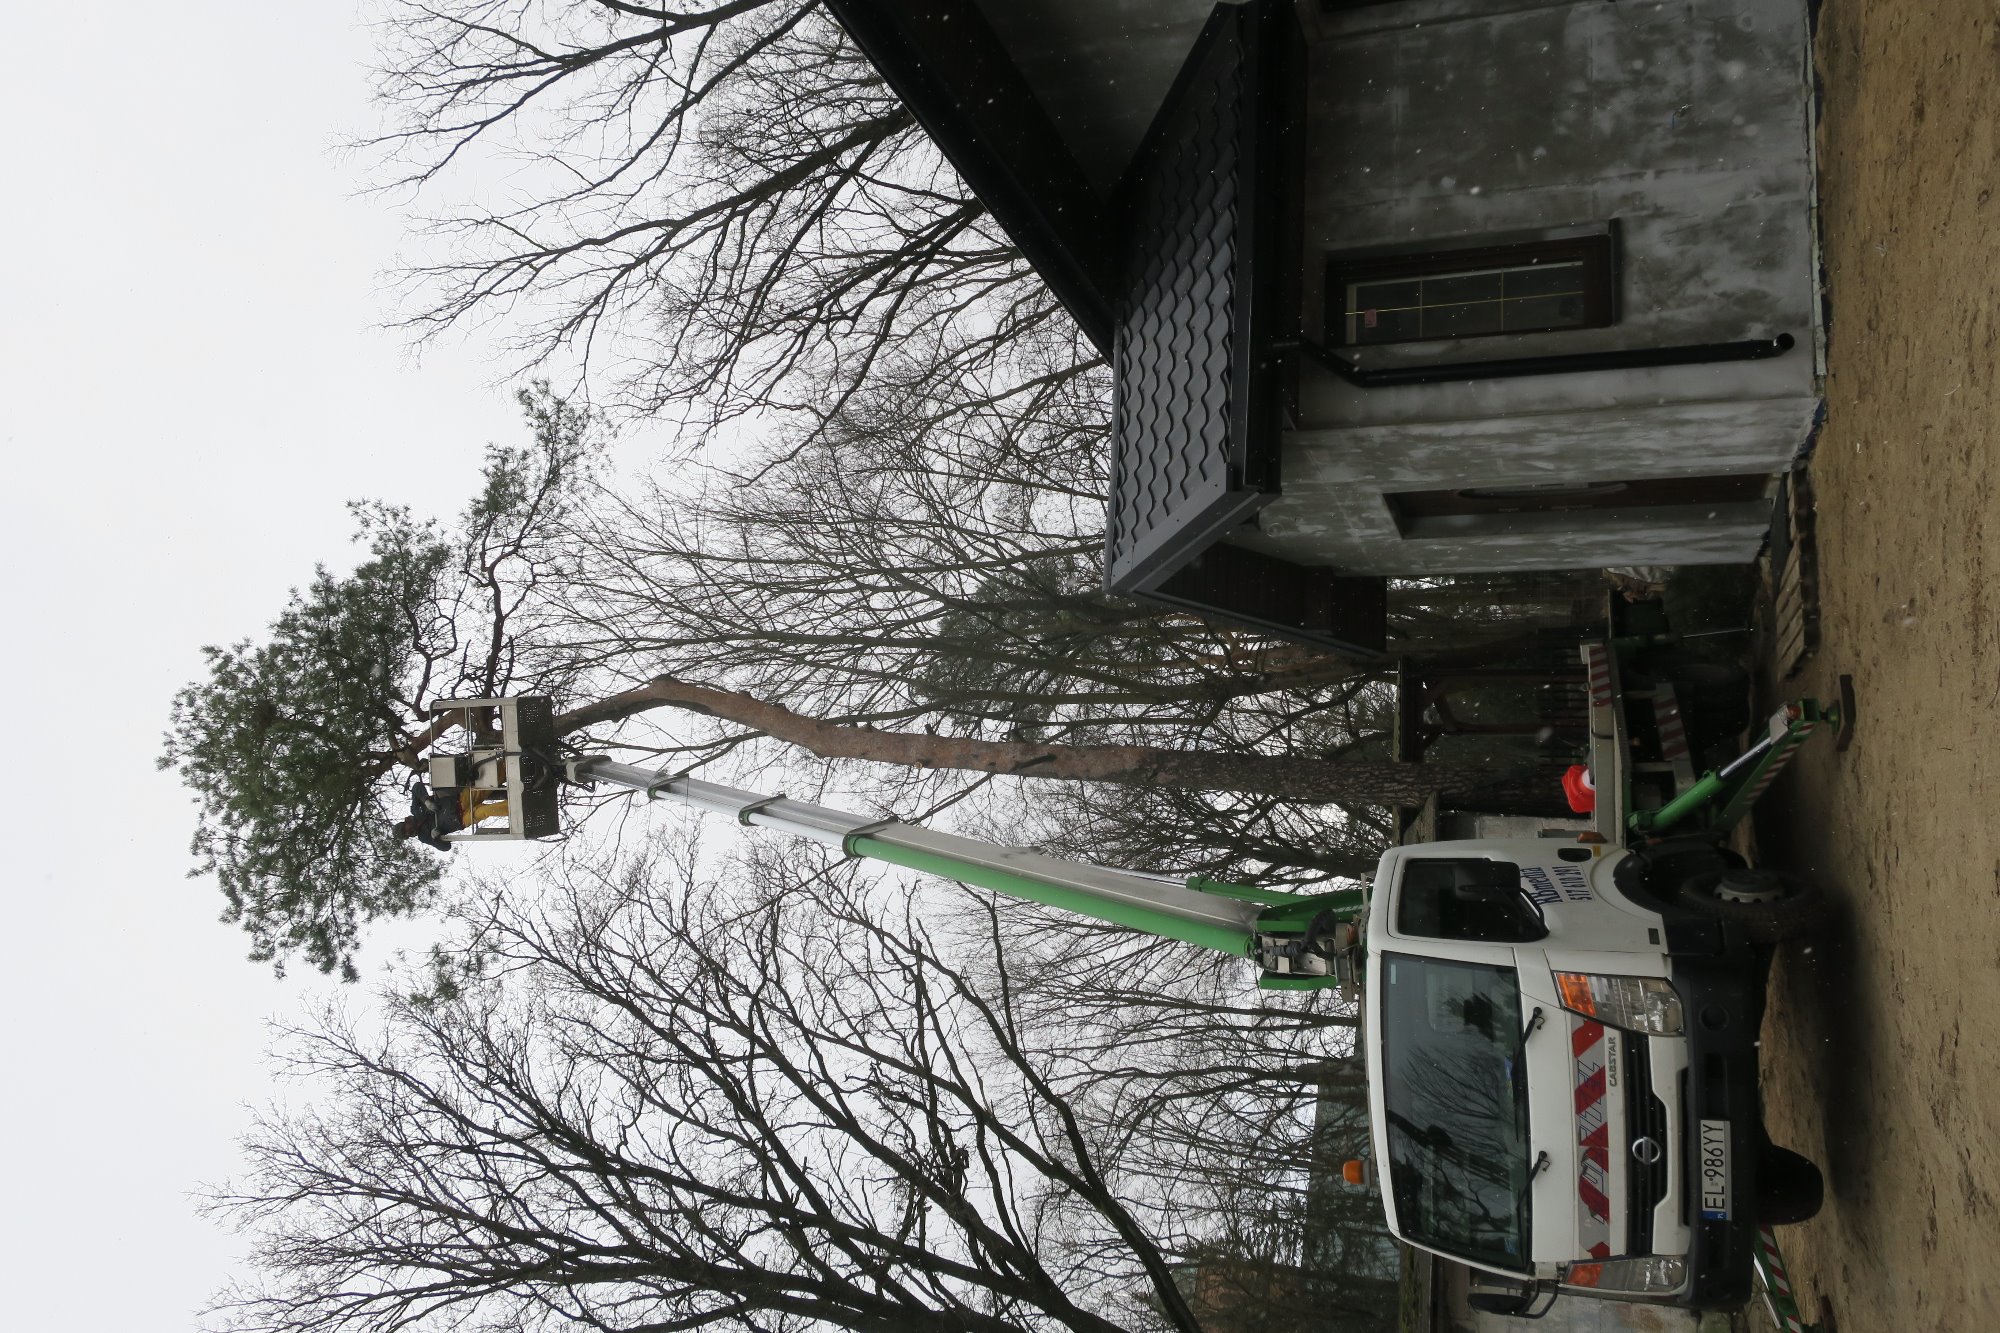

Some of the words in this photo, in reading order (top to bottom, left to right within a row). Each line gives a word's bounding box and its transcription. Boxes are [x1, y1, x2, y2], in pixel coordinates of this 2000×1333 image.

[1552, 865, 1581, 876] 291
[1559, 877, 1586, 888] 610
[1565, 890, 1592, 901] 517
[1609, 1036, 1618, 1088] CABSTAR
[1703, 1123, 1724, 1178] 986YY
[1704, 1185, 1725, 1210] EL
